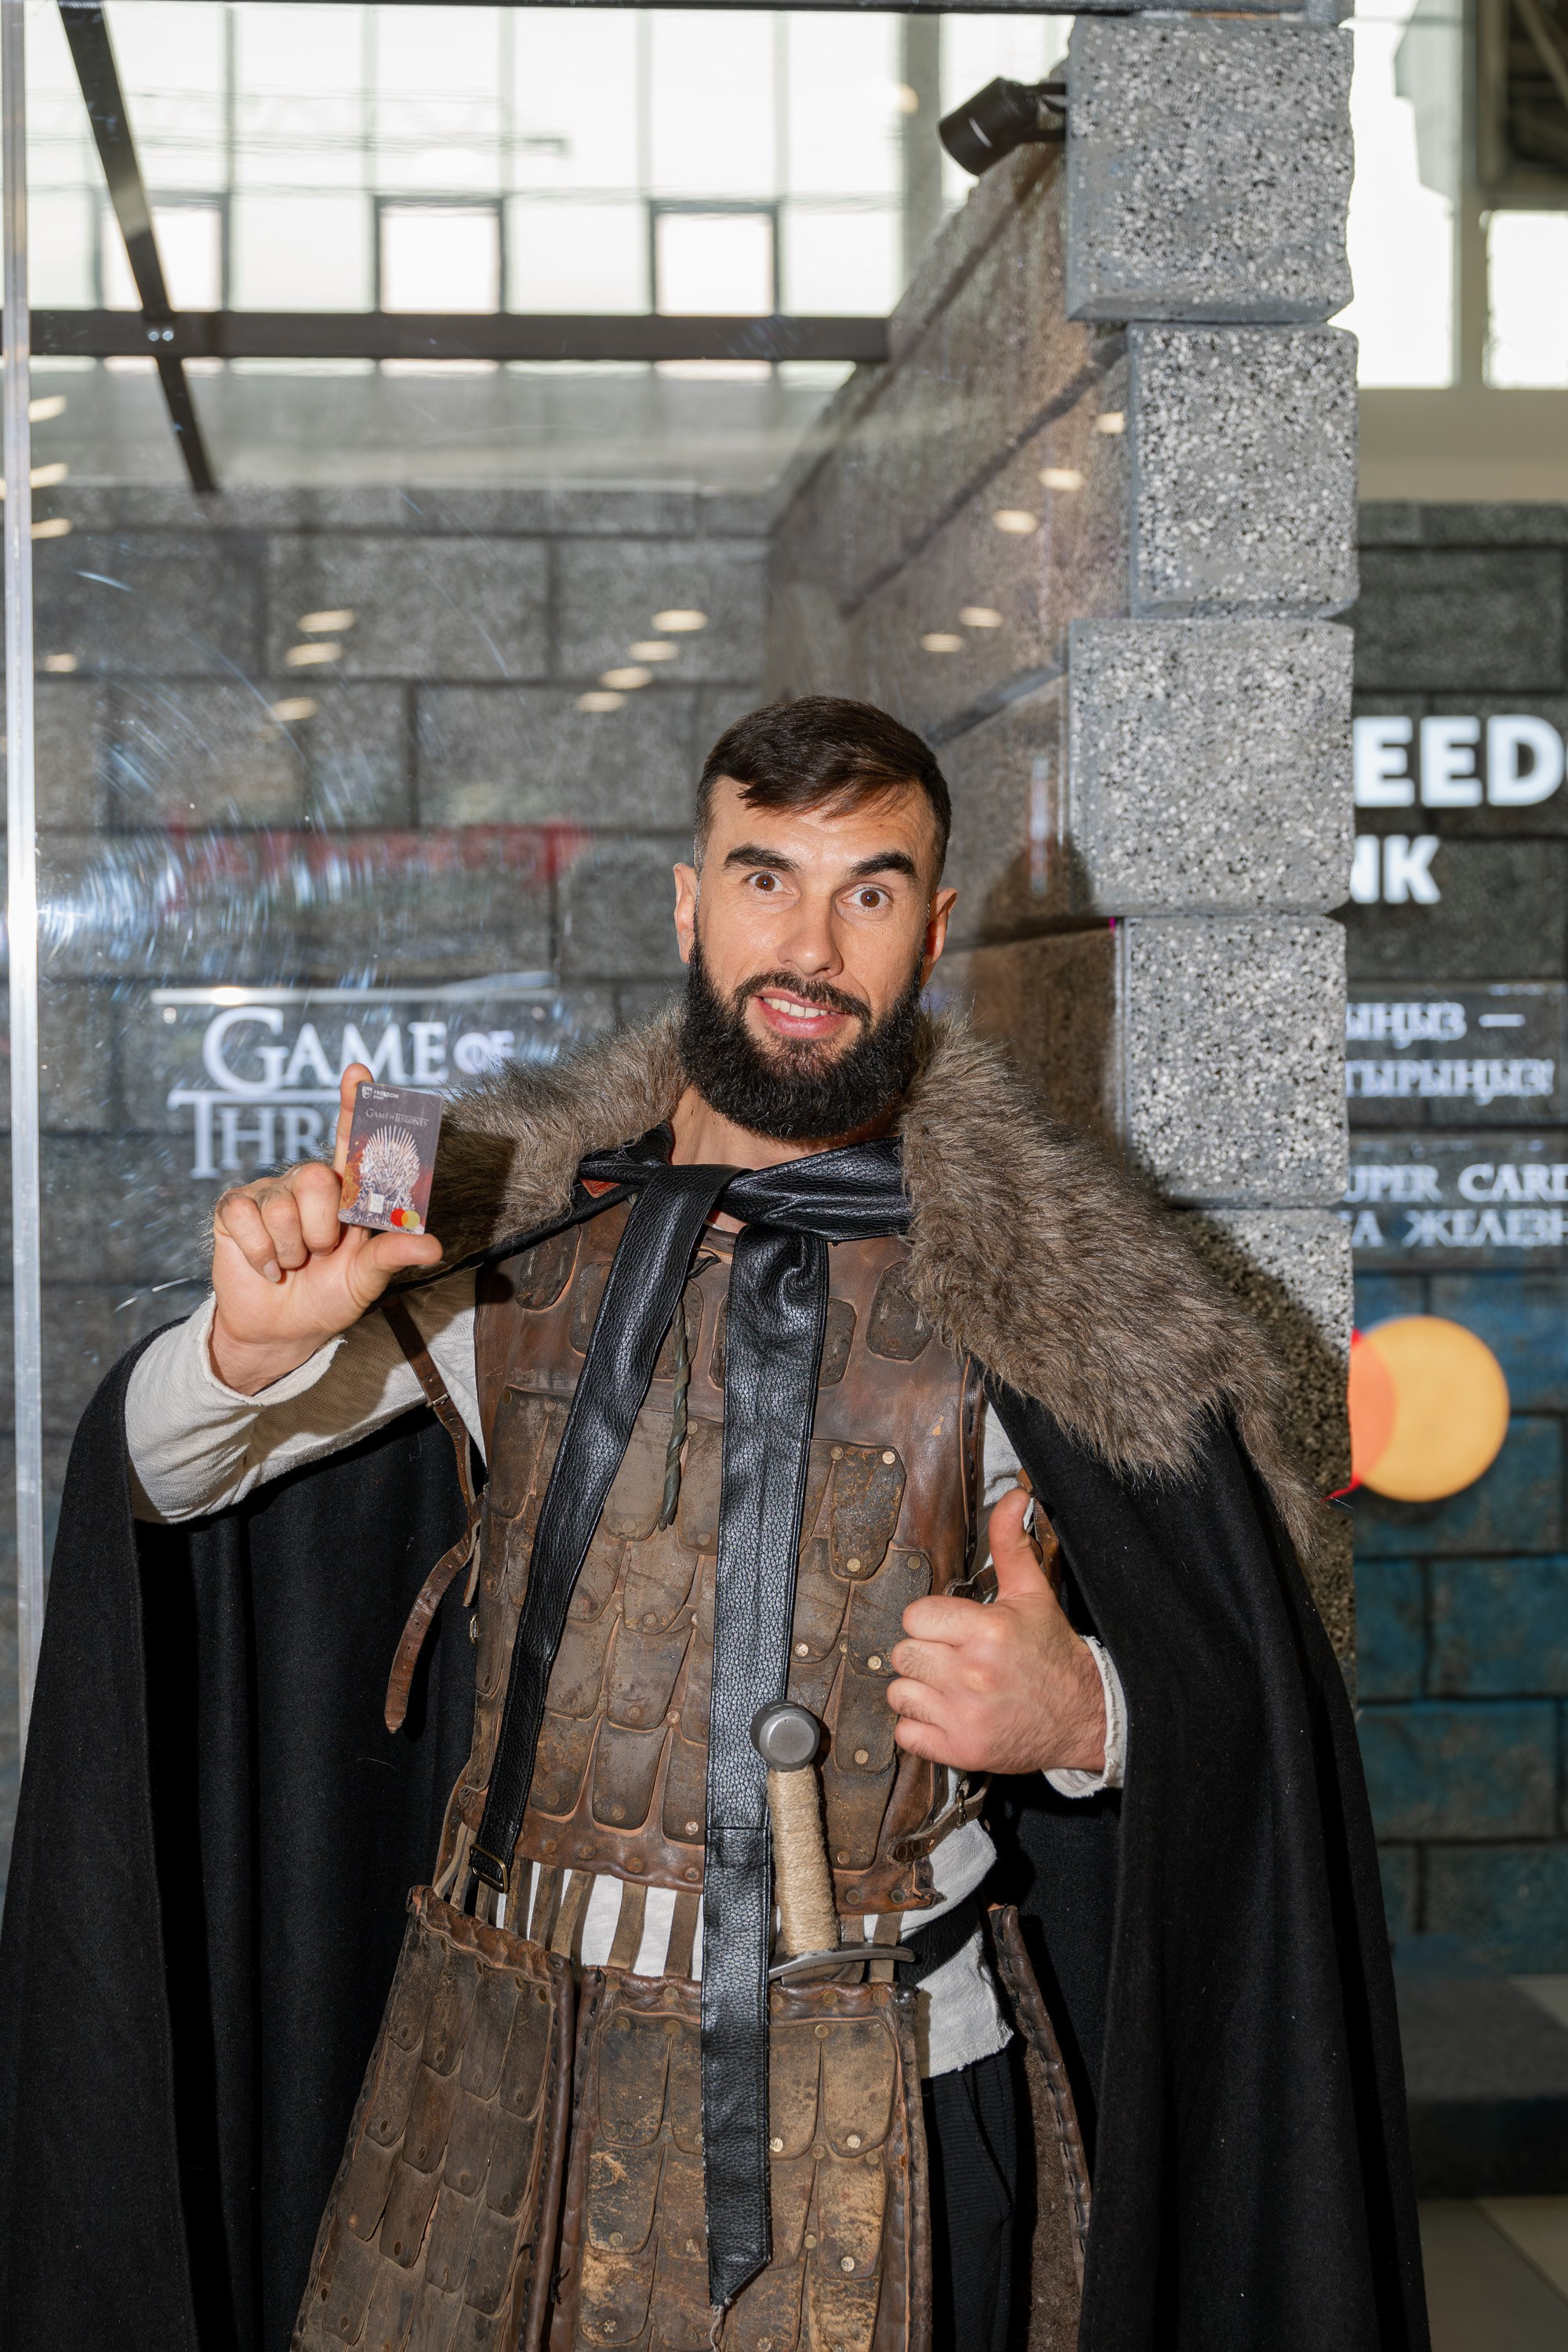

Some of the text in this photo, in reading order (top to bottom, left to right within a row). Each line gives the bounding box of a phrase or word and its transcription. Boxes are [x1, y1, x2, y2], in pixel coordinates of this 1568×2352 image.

[1352, 714, 1568, 808] EED
[202, 1006, 515, 1096] GAME OF
[373, 1090, 400, 1099] FREEDOM
[166, 1088, 341, 1179] THR
[365, 1107, 390, 1120] GAME
[394, 1112, 430, 1127] THRONES
